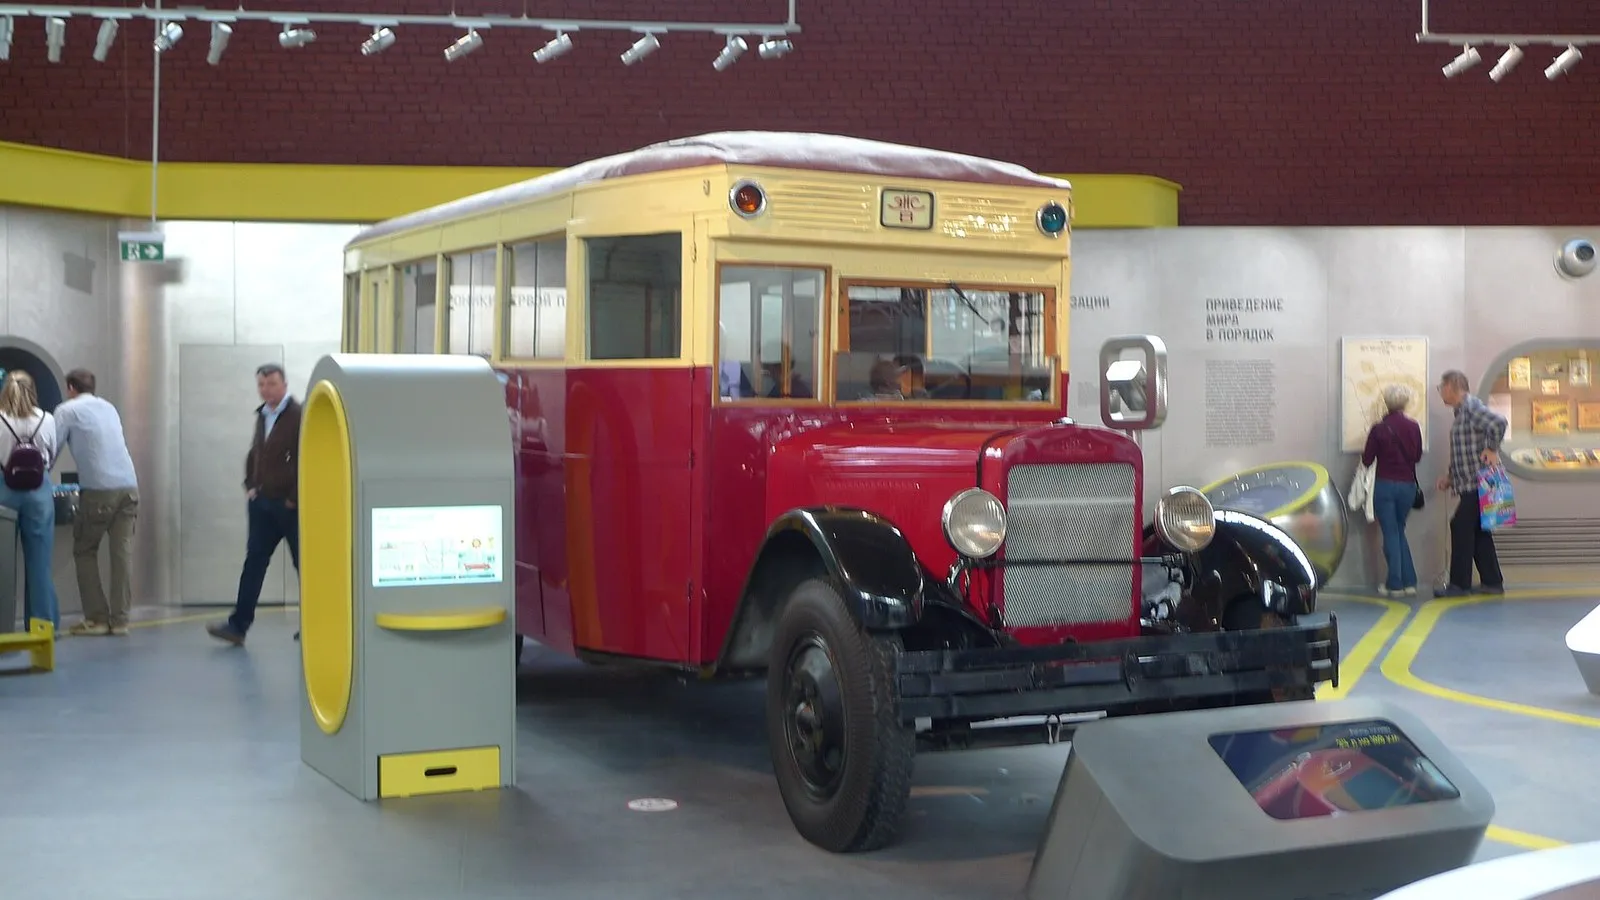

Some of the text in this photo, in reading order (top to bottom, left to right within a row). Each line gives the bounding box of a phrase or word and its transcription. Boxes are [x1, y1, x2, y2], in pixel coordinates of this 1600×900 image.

[1070, 295, 1110, 310] ЗАЦИИ
[1205, 298, 1284, 313] ПРИВЕДЕНИЕ
[1205, 313, 1240, 327] МИРА
[1205, 328, 1275, 343] В ПОРЯДОК
